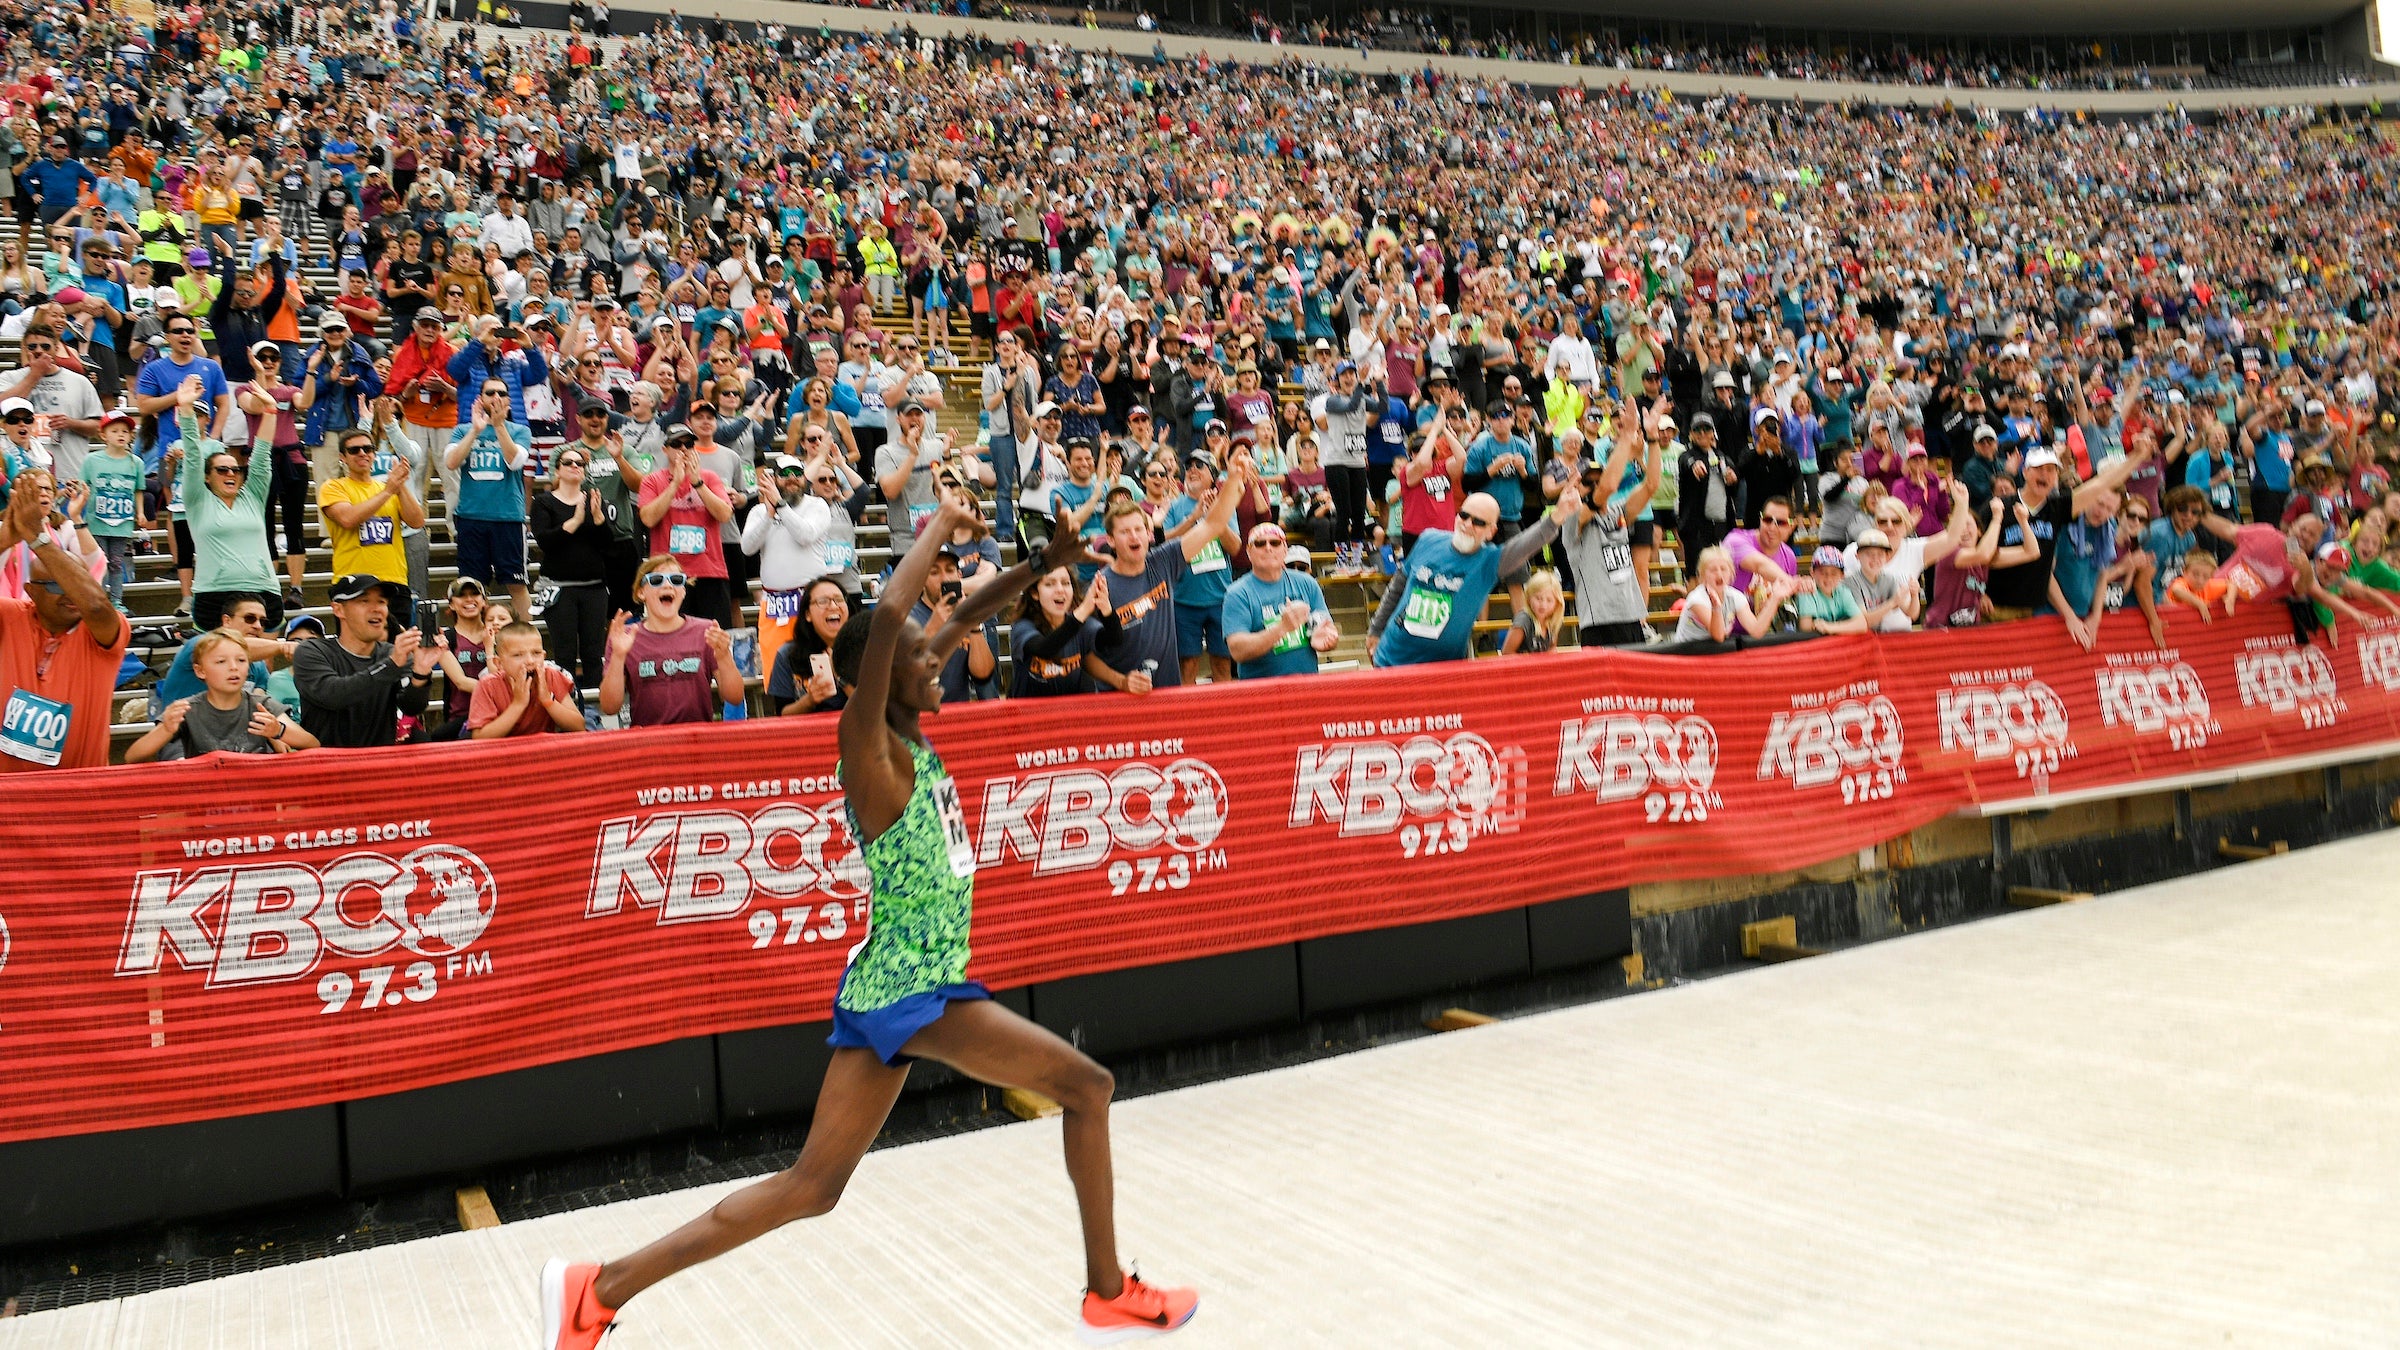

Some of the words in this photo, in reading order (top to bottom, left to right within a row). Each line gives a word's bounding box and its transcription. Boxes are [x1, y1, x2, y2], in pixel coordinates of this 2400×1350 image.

[107, 496, 134, 515] 218
[368, 521, 392, 540] 197
[1581, 695, 1624, 714] WORLD
[1661, 698, 1695, 713] ROCK
[1849, 679, 1880, 698] ROCK
[22, 705, 68, 742] 100
[1322, 720, 1376, 738] WORLD
[1380, 717, 1421, 735] CLASS
[1425, 713, 1463, 731] ROCK
[1015, 746, 1079, 769] WORLD
[1085, 742, 1134, 761] CLASS
[1140, 738, 1184, 757] ROCK
[2015, 746, 2060, 779] 97.3
[637, 785, 713, 806] WORLD
[721, 779, 782, 799] CLASS
[789, 775, 843, 794] ROCK
[1840, 769, 1894, 805] 97.3
[1644, 791, 1708, 823] 97.3
[181, 834, 275, 858] WORLD
[285, 827, 358, 850] CLASS
[366, 820, 432, 842] ROCK
[1399, 817, 1469, 859] 97.3
[1107, 854, 1190, 896] 97.3
[1195, 848, 1228, 872] FM
[747, 902, 847, 950] 97.3
[854, 899, 867, 921] F
[316, 961, 439, 1015] 97.3
[446, 951, 494, 980] FM
